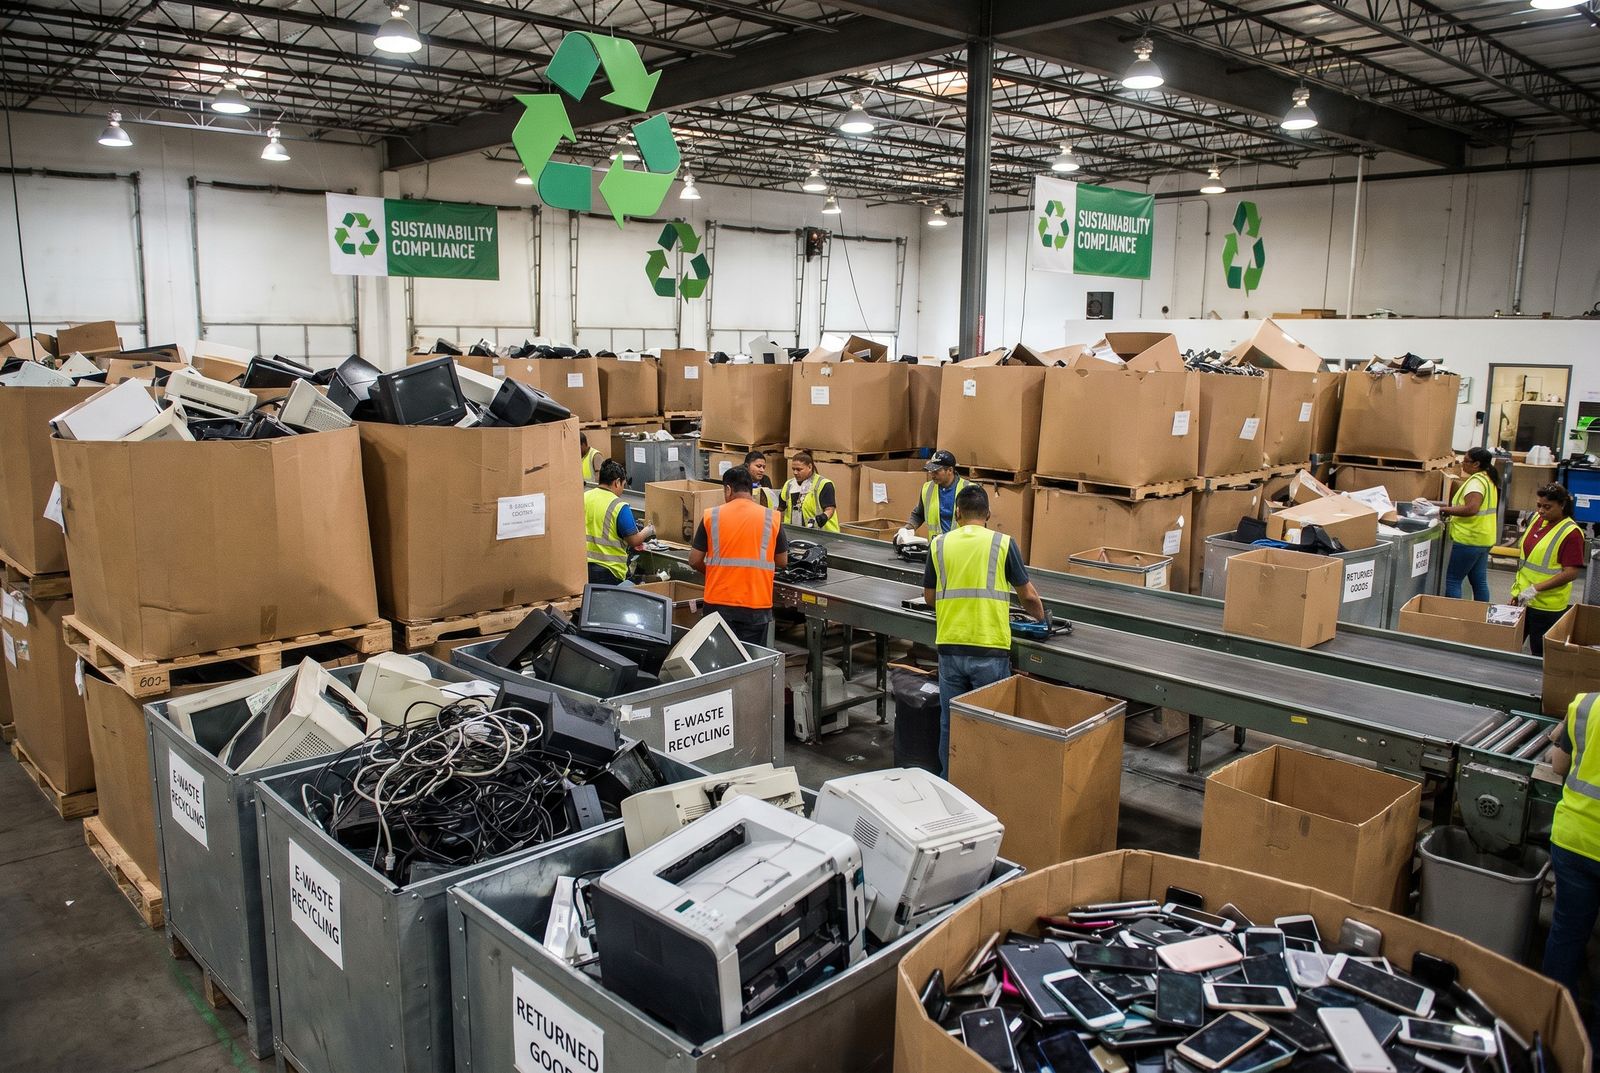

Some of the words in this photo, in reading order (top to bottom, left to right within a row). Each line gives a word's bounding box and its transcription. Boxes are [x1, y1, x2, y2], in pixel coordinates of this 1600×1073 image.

[391, 220, 493, 242] SUSTAINABILITY
[1078, 210, 1150, 235] SUSTAINABILITY
[392, 240, 476, 259] COMPLIANCE
[1077, 231, 1137, 254] COMPLIANCE
[674, 706, 724, 732] E-WASTE
[668, 724, 730, 753] RECYCLING
[172, 769, 200, 804] E-WASTE
[171, 789, 205, 829] RECYCLING
[295, 865, 334, 912] E-WASTE
[291, 887, 340, 945] RECYCLING
[516, 996, 599, 1073] RETURNED
[530, 1041, 573, 1073] GOO
